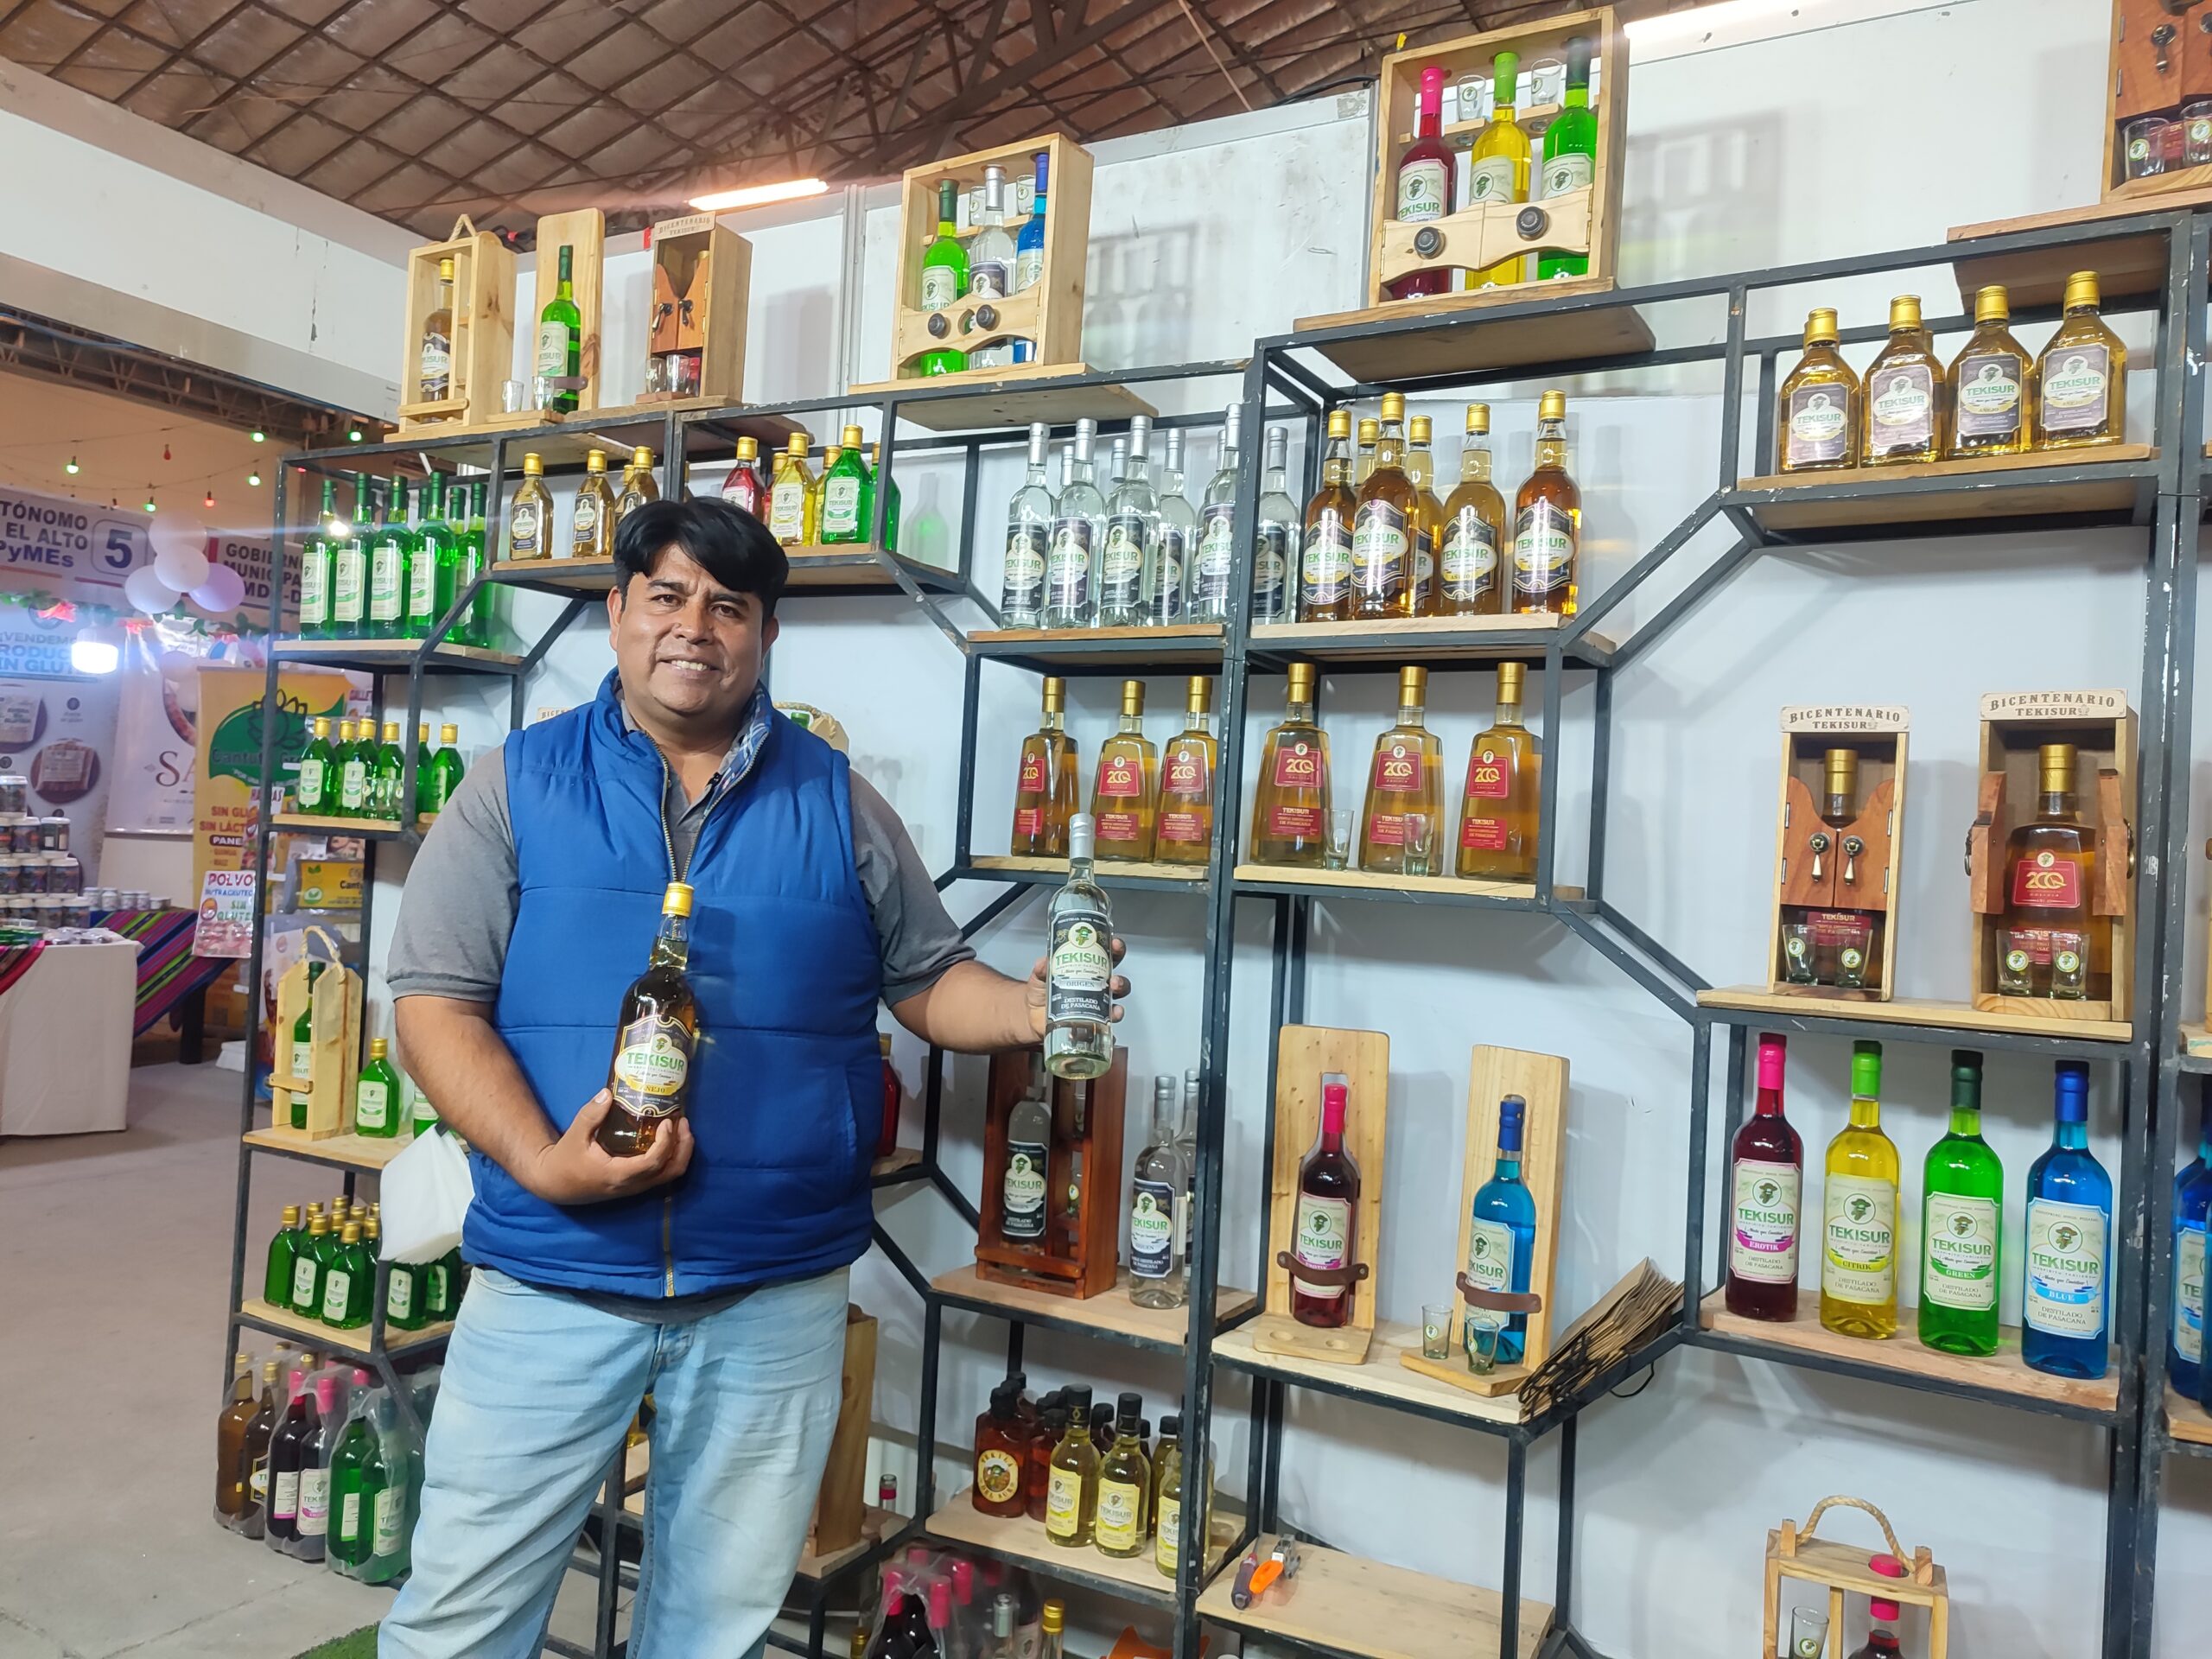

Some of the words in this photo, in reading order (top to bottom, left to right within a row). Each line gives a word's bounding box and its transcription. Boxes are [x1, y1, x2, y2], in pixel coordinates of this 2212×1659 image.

[2050, 376, 2101, 390] TEKISUR
[1967, 385, 2015, 396] TEKISUR
[1878, 395, 1925, 409] TEKISUR
[1797, 413, 1841, 423] TEKISUR
[5, 522, 30, 541] EL
[37, 527, 88, 550] ALTO
[105, 529, 133, 569] 5
[1306, 552, 1349, 563] TEKSUR
[1990, 693, 2114, 711] BICENTENARIO
[1789, 708, 1900, 724] BICENTENARIO
[2015, 707, 2077, 716] TEKISUR
[1812, 721, 1867, 729] TEKISUR
[213, 836, 243, 846] PANE
[207, 873, 257, 887] POLVO
[217, 911, 253, 921] GLUTE
[1821, 912, 1856, 922] TEKISUR
[1055, 952, 1108, 968] TEKISUR
[1070, 1002, 1101, 1011] PASACANA
[626, 1052, 684, 1071] TEKISUR
[1738, 1208, 1794, 1224] TEKISUR
[1829, 1224, 1890, 1243] TEKISUR
[1300, 1233, 1343, 1249] TEKISUR
[1749, 1241, 1779, 1251] EROTIK
[1932, 1237, 1992, 1255] TEKISUR
[1748, 1255, 1781, 1264] DESTILADO
[1842, 1260, 1872, 1270] CITRIK
[2032, 1252, 2099, 1274] TEKISUR
[1754, 1261, 1783, 1270] PASACANA
[1946, 1269, 1975, 1279] GREEN
[1839, 1277, 1877, 1287] DESTILADO
[1845, 1283, 1880, 1294] PASACANA
[1942, 1283, 1979, 1293] DESTILADO
[2049, 1290, 2075, 1300] BLUE
[2041, 1306, 2083, 1319] DESTILADO
[2048, 1313, 2086, 1325] PASACANA
